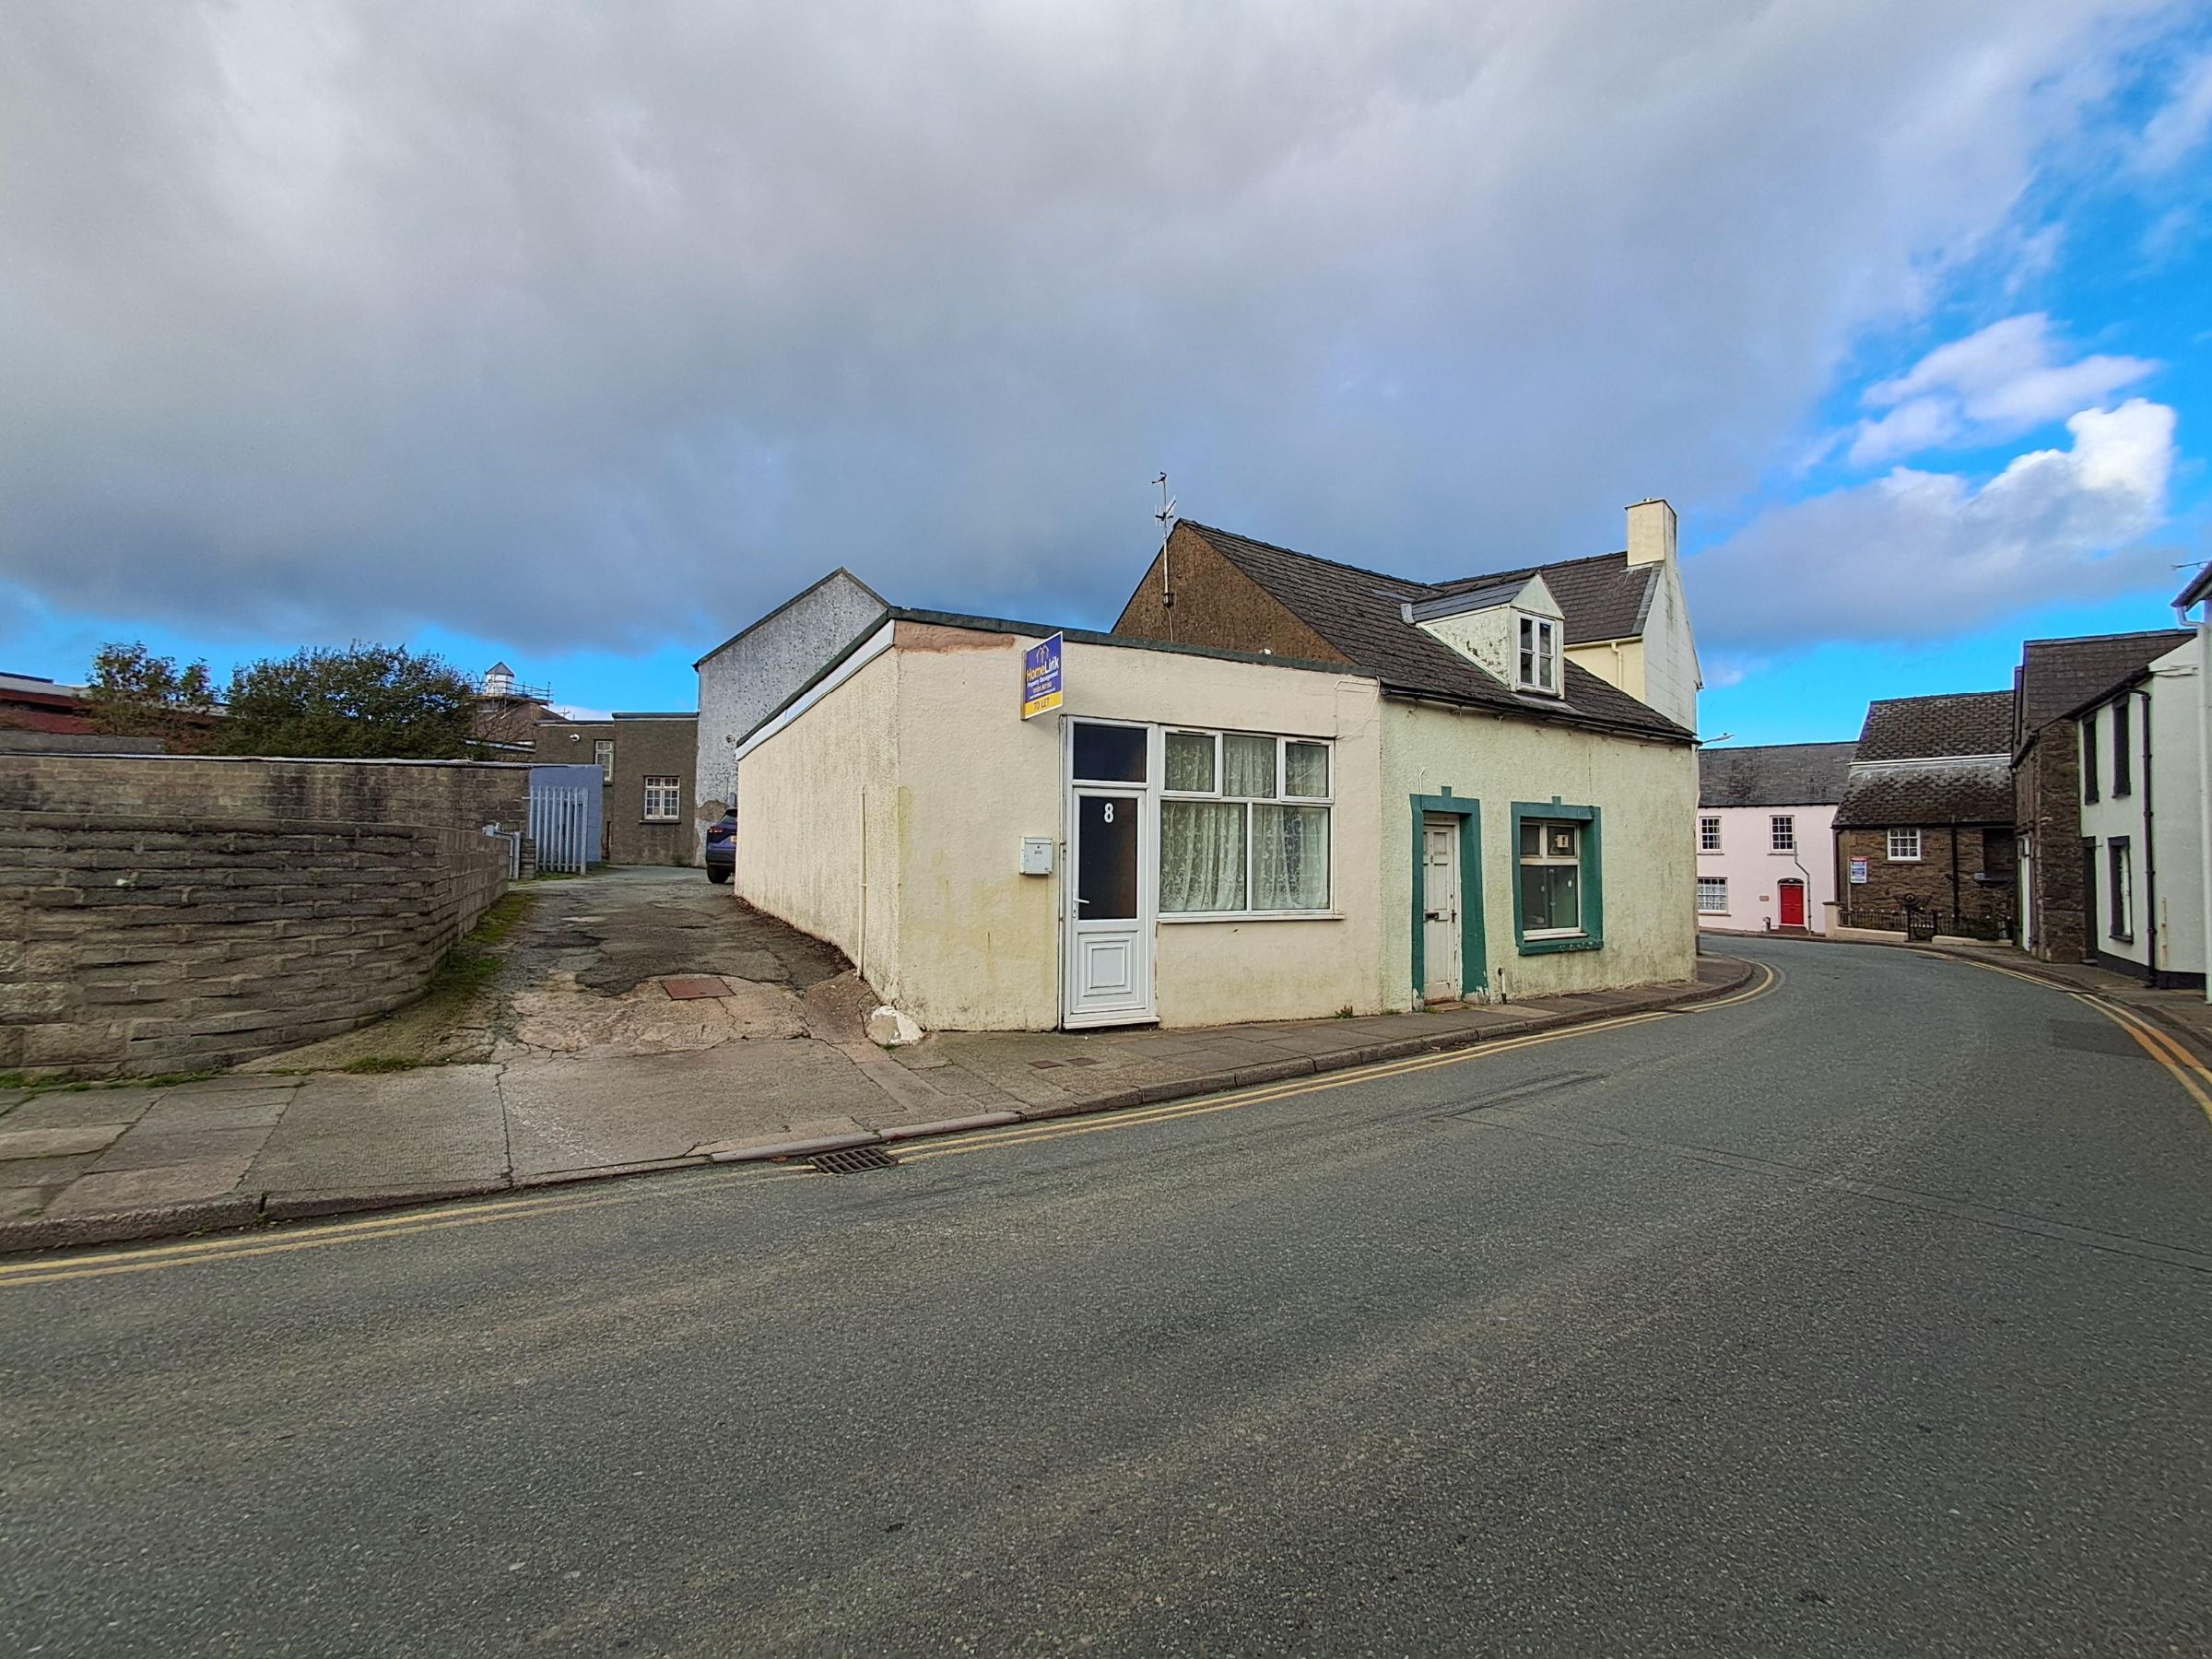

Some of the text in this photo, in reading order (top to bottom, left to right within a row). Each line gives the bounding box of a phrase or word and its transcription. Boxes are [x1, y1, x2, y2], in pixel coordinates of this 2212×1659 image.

[1027, 656, 1059, 682] HomeLink
[1034, 698, 1050, 710] TO LET
[1104, 803, 1113, 823] 8
